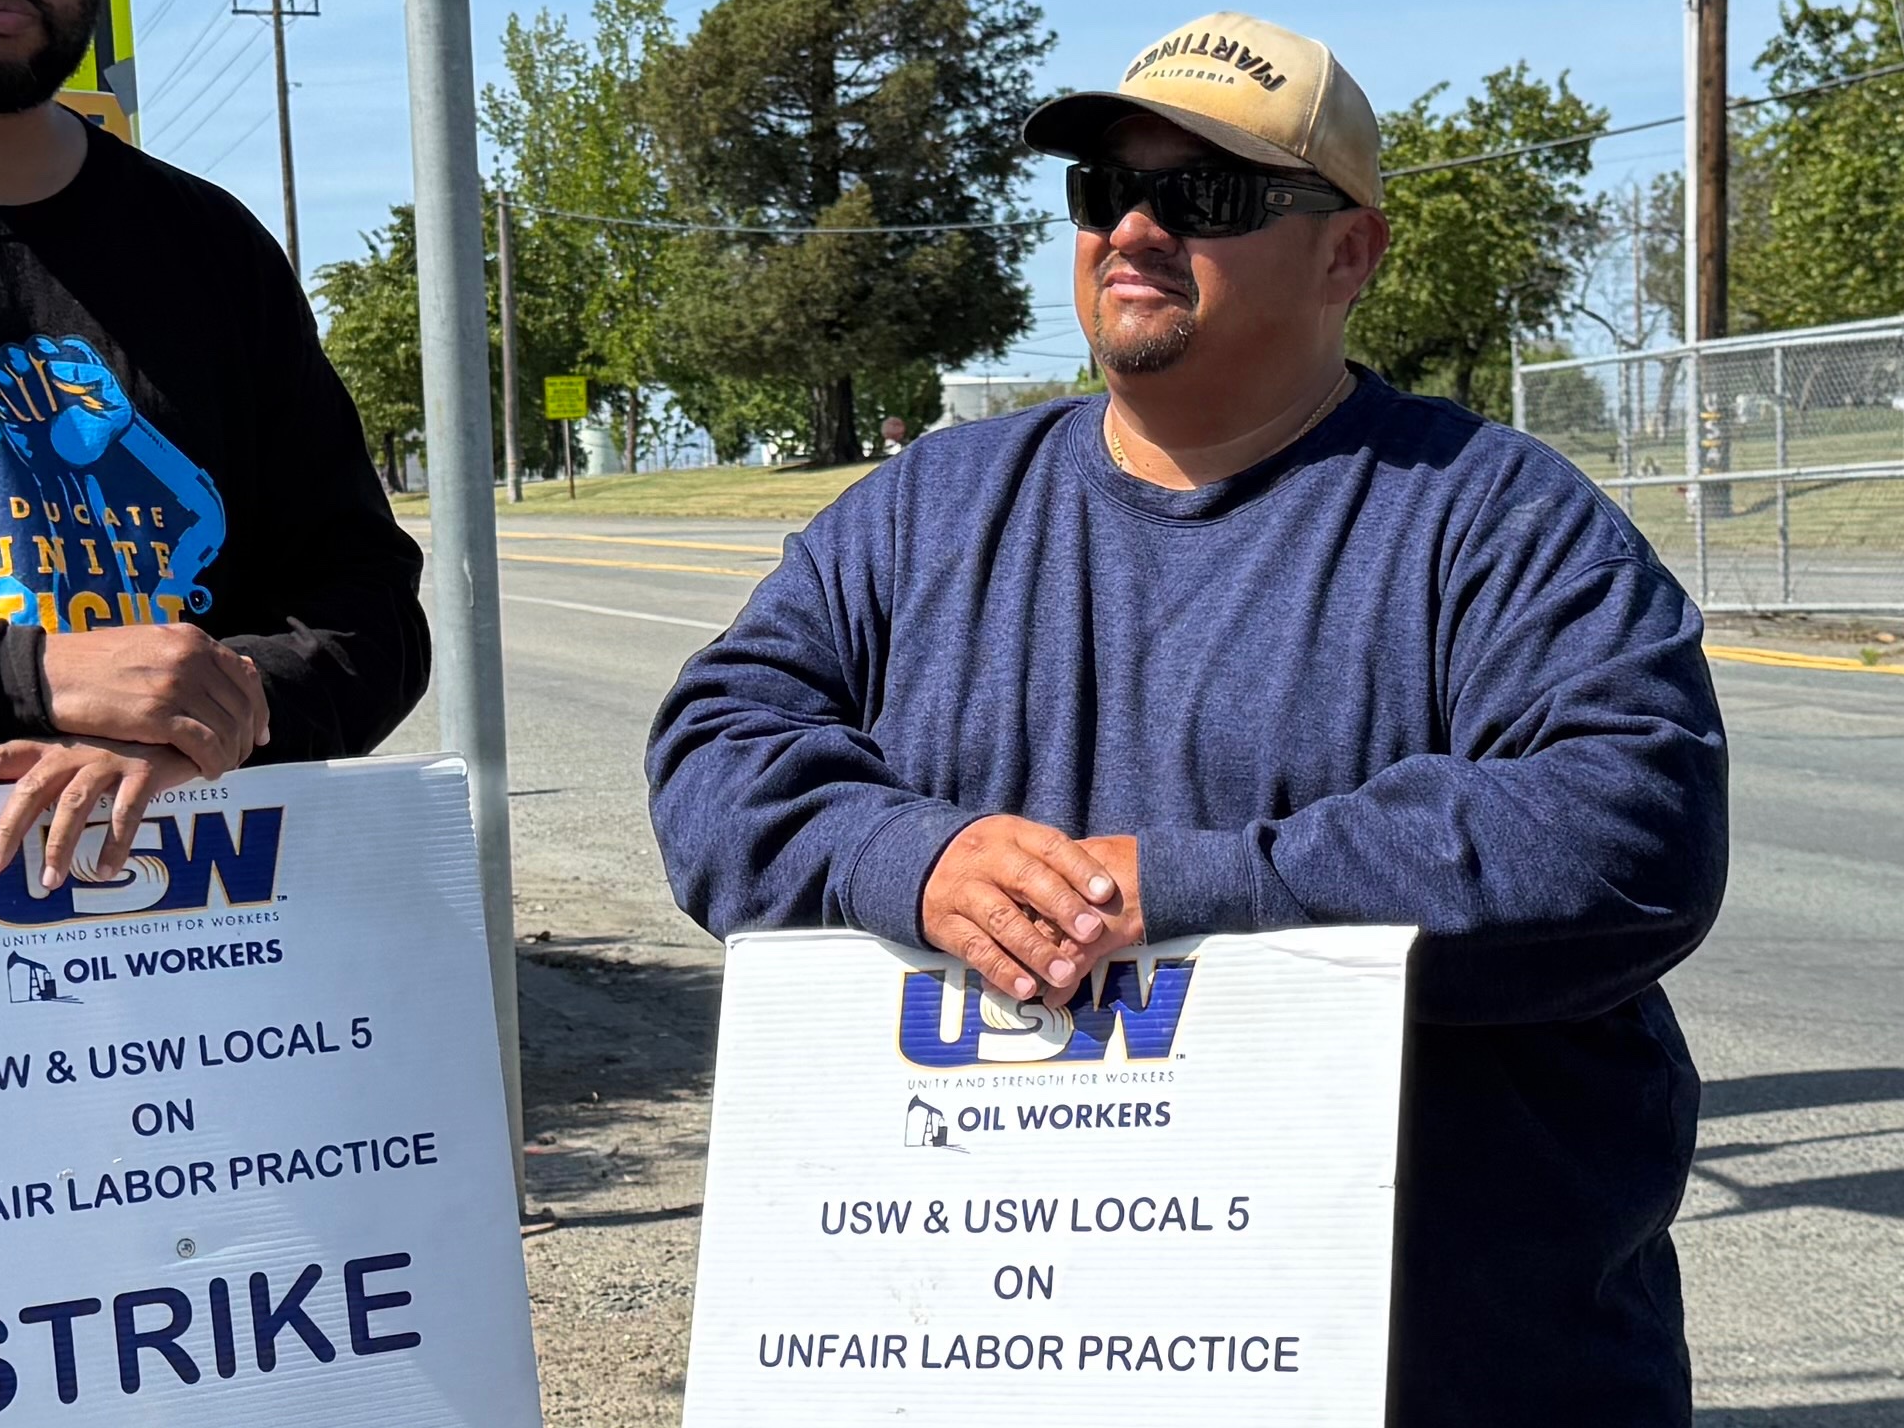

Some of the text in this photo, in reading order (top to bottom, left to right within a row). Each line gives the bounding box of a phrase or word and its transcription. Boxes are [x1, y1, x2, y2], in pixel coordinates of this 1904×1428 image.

[1124, 31, 1288, 93] MARTINEZ
[1143, 68, 1236, 85] CALIFORNIA
[2, 910, 281, 948] UNITY AND STRENGTH FOR WORKERS
[63, 937, 284, 986] OIL WORKERS
[896, 955, 1200, 1073] USW
[45, 1047, 78, 1085] &
[88, 1034, 188, 1081] USW
[198, 1019, 341, 1070] LOCAL
[350, 1015, 374, 1050] 5
[907, 1071, 1176, 1090] UNITY AND STRENGTH FOR WORKERS
[130, 1097, 197, 1137] ON
[957, 1100, 1172, 1132] OIL WORKERS
[66, 1158, 218, 1212] LABOR
[228, 1130, 439, 1190] PRACTICE
[820, 1195, 1251, 1236] USW & USW LOCAL 5
[992, 1264, 1055, 1301] ON
[757, 1332, 1301, 1374] UNFAIR LABOR PRACTICE
